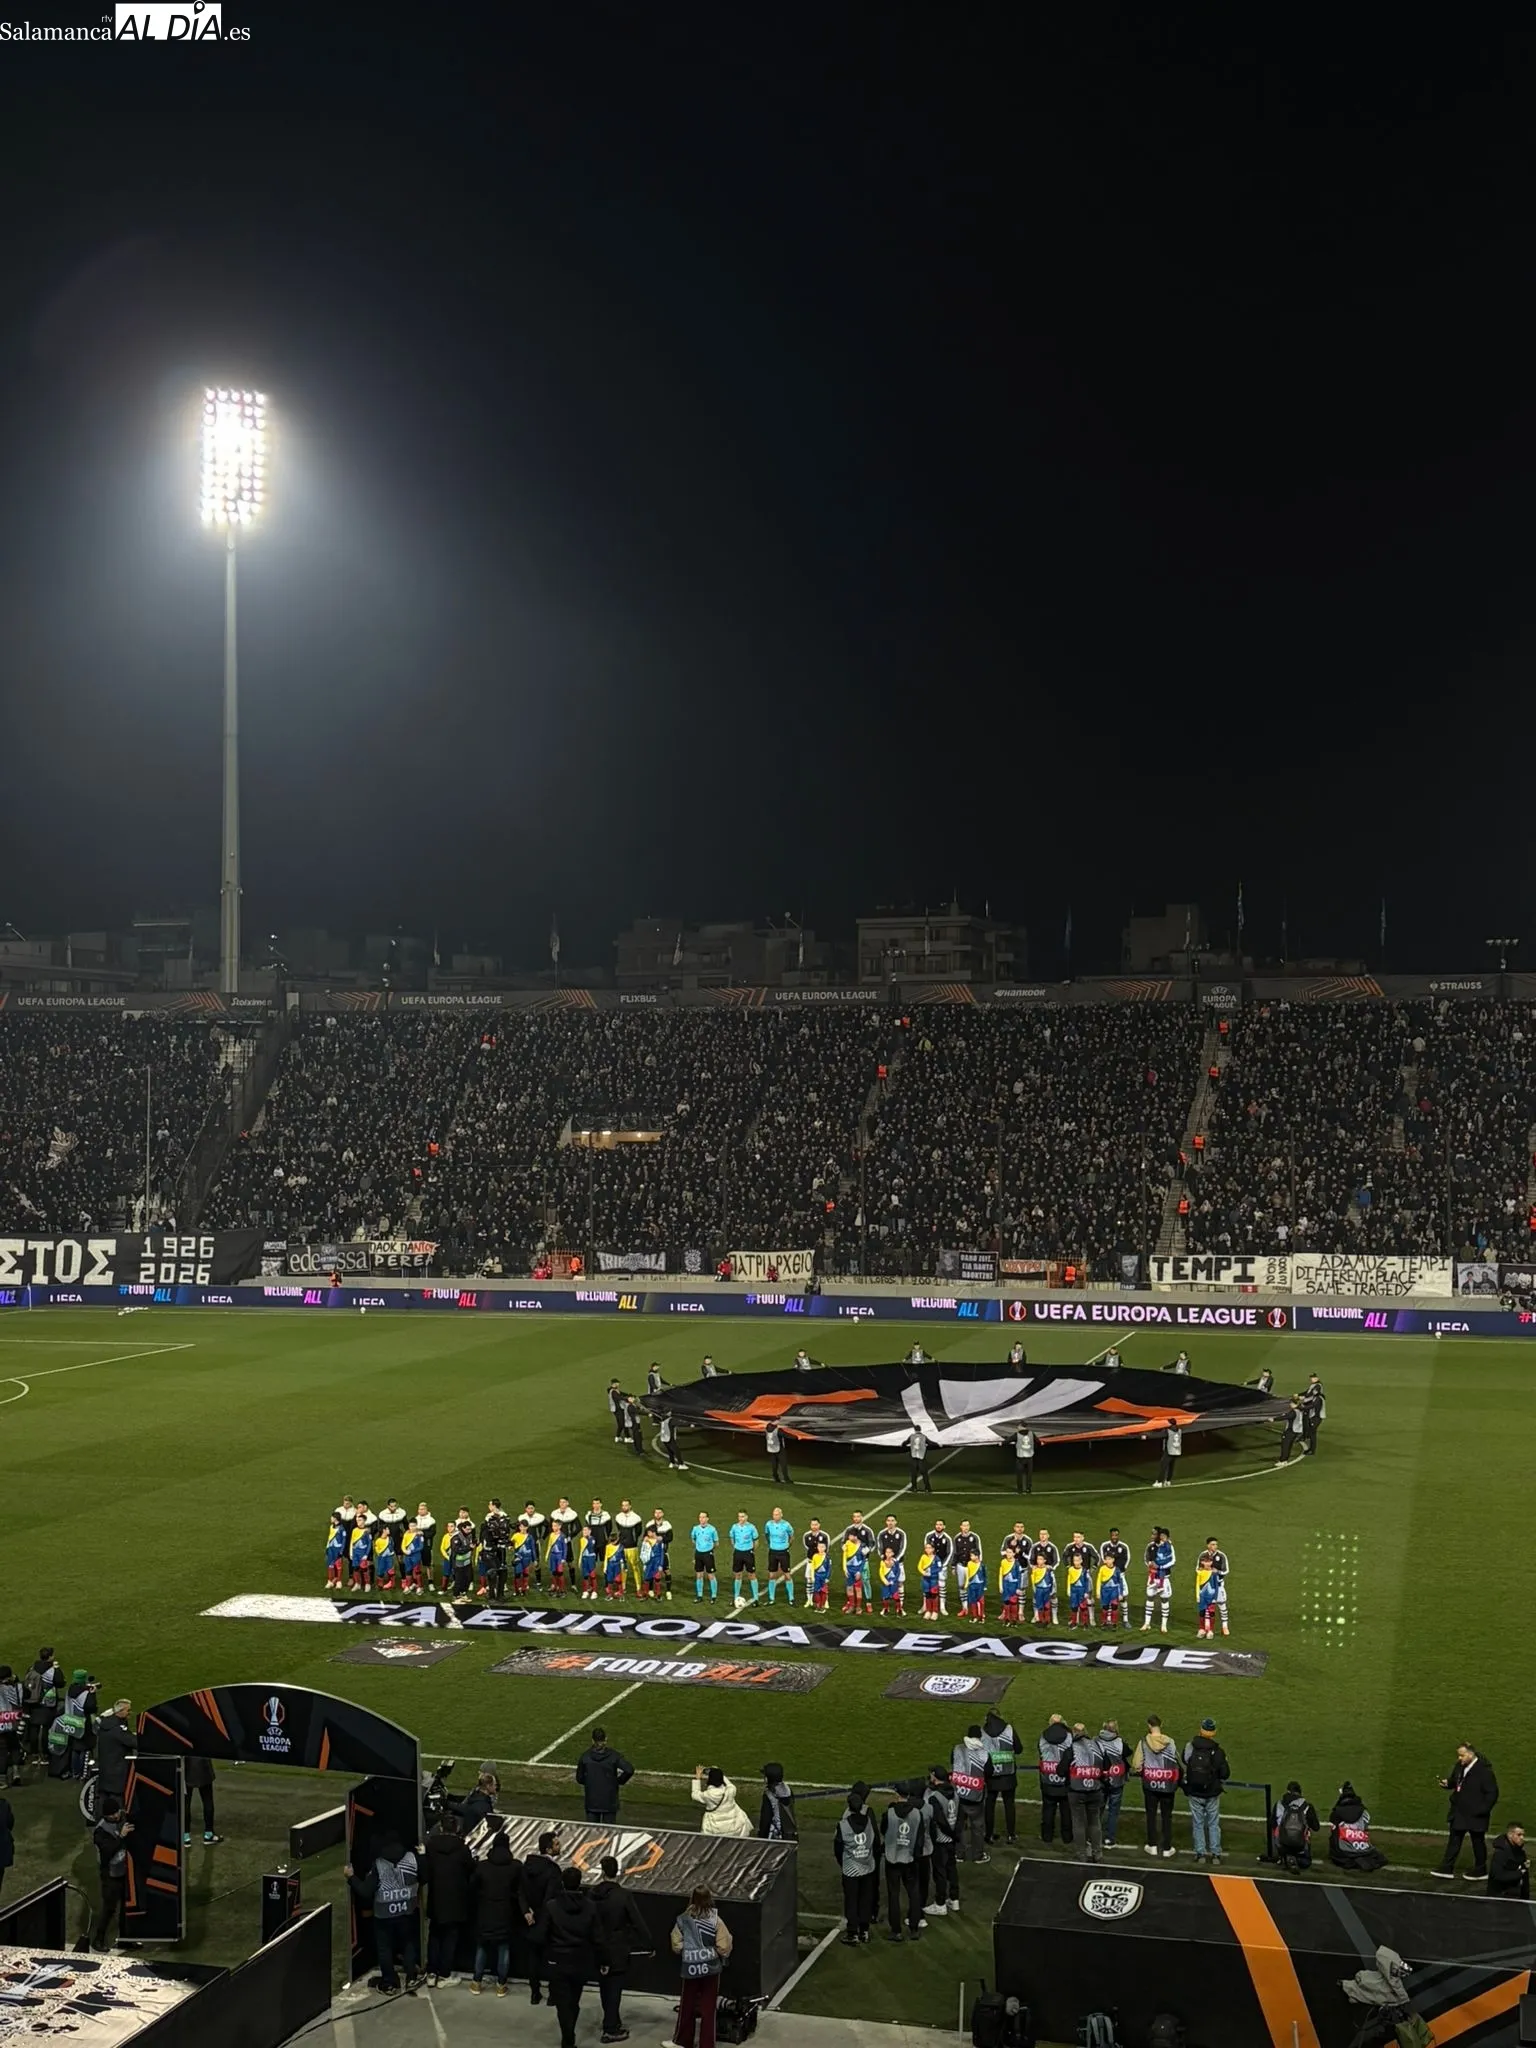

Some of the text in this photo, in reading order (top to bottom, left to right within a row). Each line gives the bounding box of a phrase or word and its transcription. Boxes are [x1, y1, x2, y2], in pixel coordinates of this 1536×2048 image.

[1440, 981, 1482, 991] STRAUSS
[17, 997, 126, 1006] UEFA EUROPA LEAGUE
[401, 995, 502, 1005] UEFA EUROPA LEAGUE
[620, 994, 657, 1004] FLIXBUS
[775, 990, 878, 1001] UEFA EUROPA LEAGUE
[1202, 995, 1237, 1003] EUROPA
[141, 1236, 215, 1259] 1926
[139, 1262, 210, 1284] 2026
[1152, 1256, 1255, 1283] TEMPI
[1306, 1281, 1345, 1295] SAME
[1350, 1282, 1413, 1297] TRAGEDY
[304, 1290, 322, 1304] ALL
[618, 1295, 638, 1310] ALL
[957, 1302, 979, 1317] ALL
[1034, 1303, 1257, 1326] UEFA EUROPA LEAGUE
[1364, 1312, 1388, 1328] ALL
[463, 1608, 810, 1645] EUROPA
[839, 1628, 1220, 1671] LEAGUE
[545, 1655, 783, 1684] #FOOTBALL
[259, 1735, 292, 1746] EUROPA
[262, 1743, 289, 1753] LEAGUE
[952, 1773, 980, 1787] PHOTO
[1150, 1780, 1166, 1789] 014
[388, 1902, 408, 1914] 014
[684, 1947, 716, 1961] PITCH
[688, 1963, 709, 1976] 016
